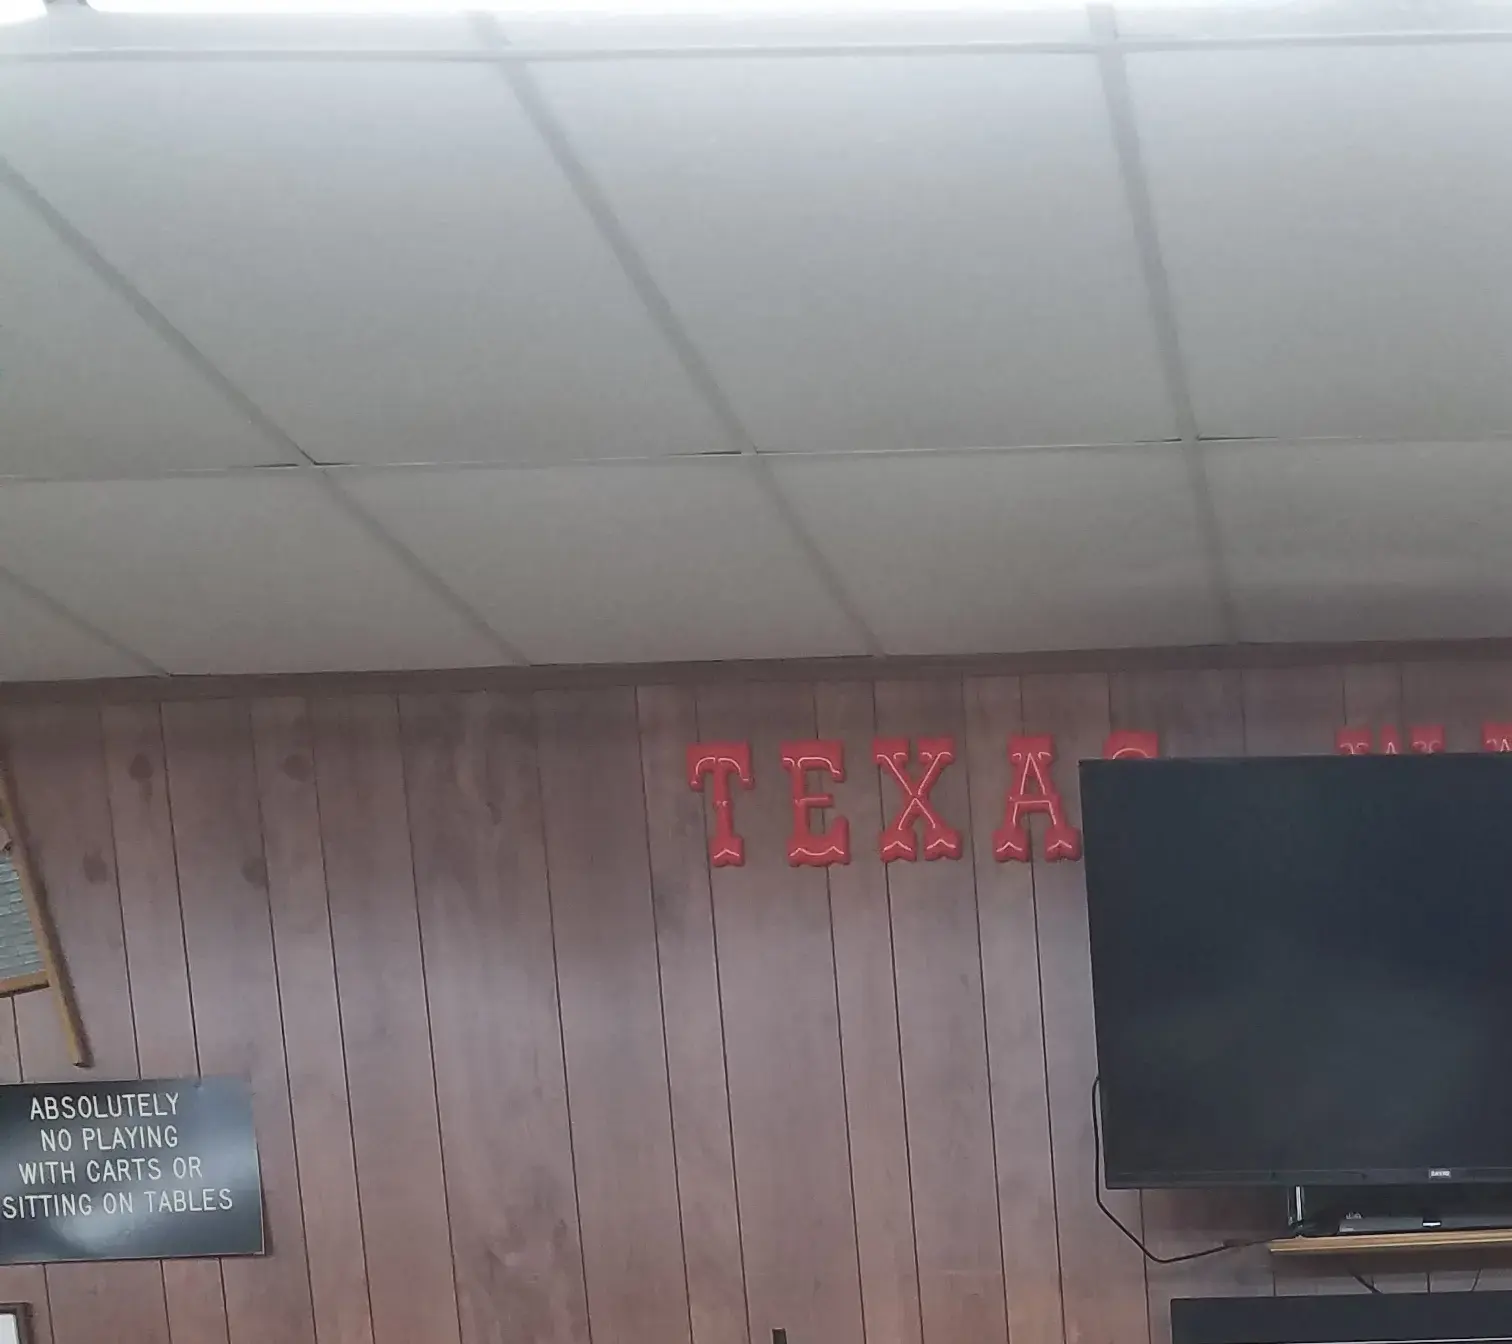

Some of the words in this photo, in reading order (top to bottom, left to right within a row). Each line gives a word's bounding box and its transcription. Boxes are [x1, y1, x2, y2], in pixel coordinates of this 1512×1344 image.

[686, 731, 1158, 867] TEXA
[30, 1092, 179, 1121] ABSOLUTELY
[40, 1129, 71, 1151] NO
[82, 1126, 178, 1150] PLAYING
[19, 1161, 76, 1185] WITH
[86, 1158, 161, 1182] CARTS
[173, 1156, 202, 1179] OR
[2, 1195, 92, 1219] SITTING
[103, 1192, 132, 1214] ON
[144, 1188, 233, 1212] TABLES
